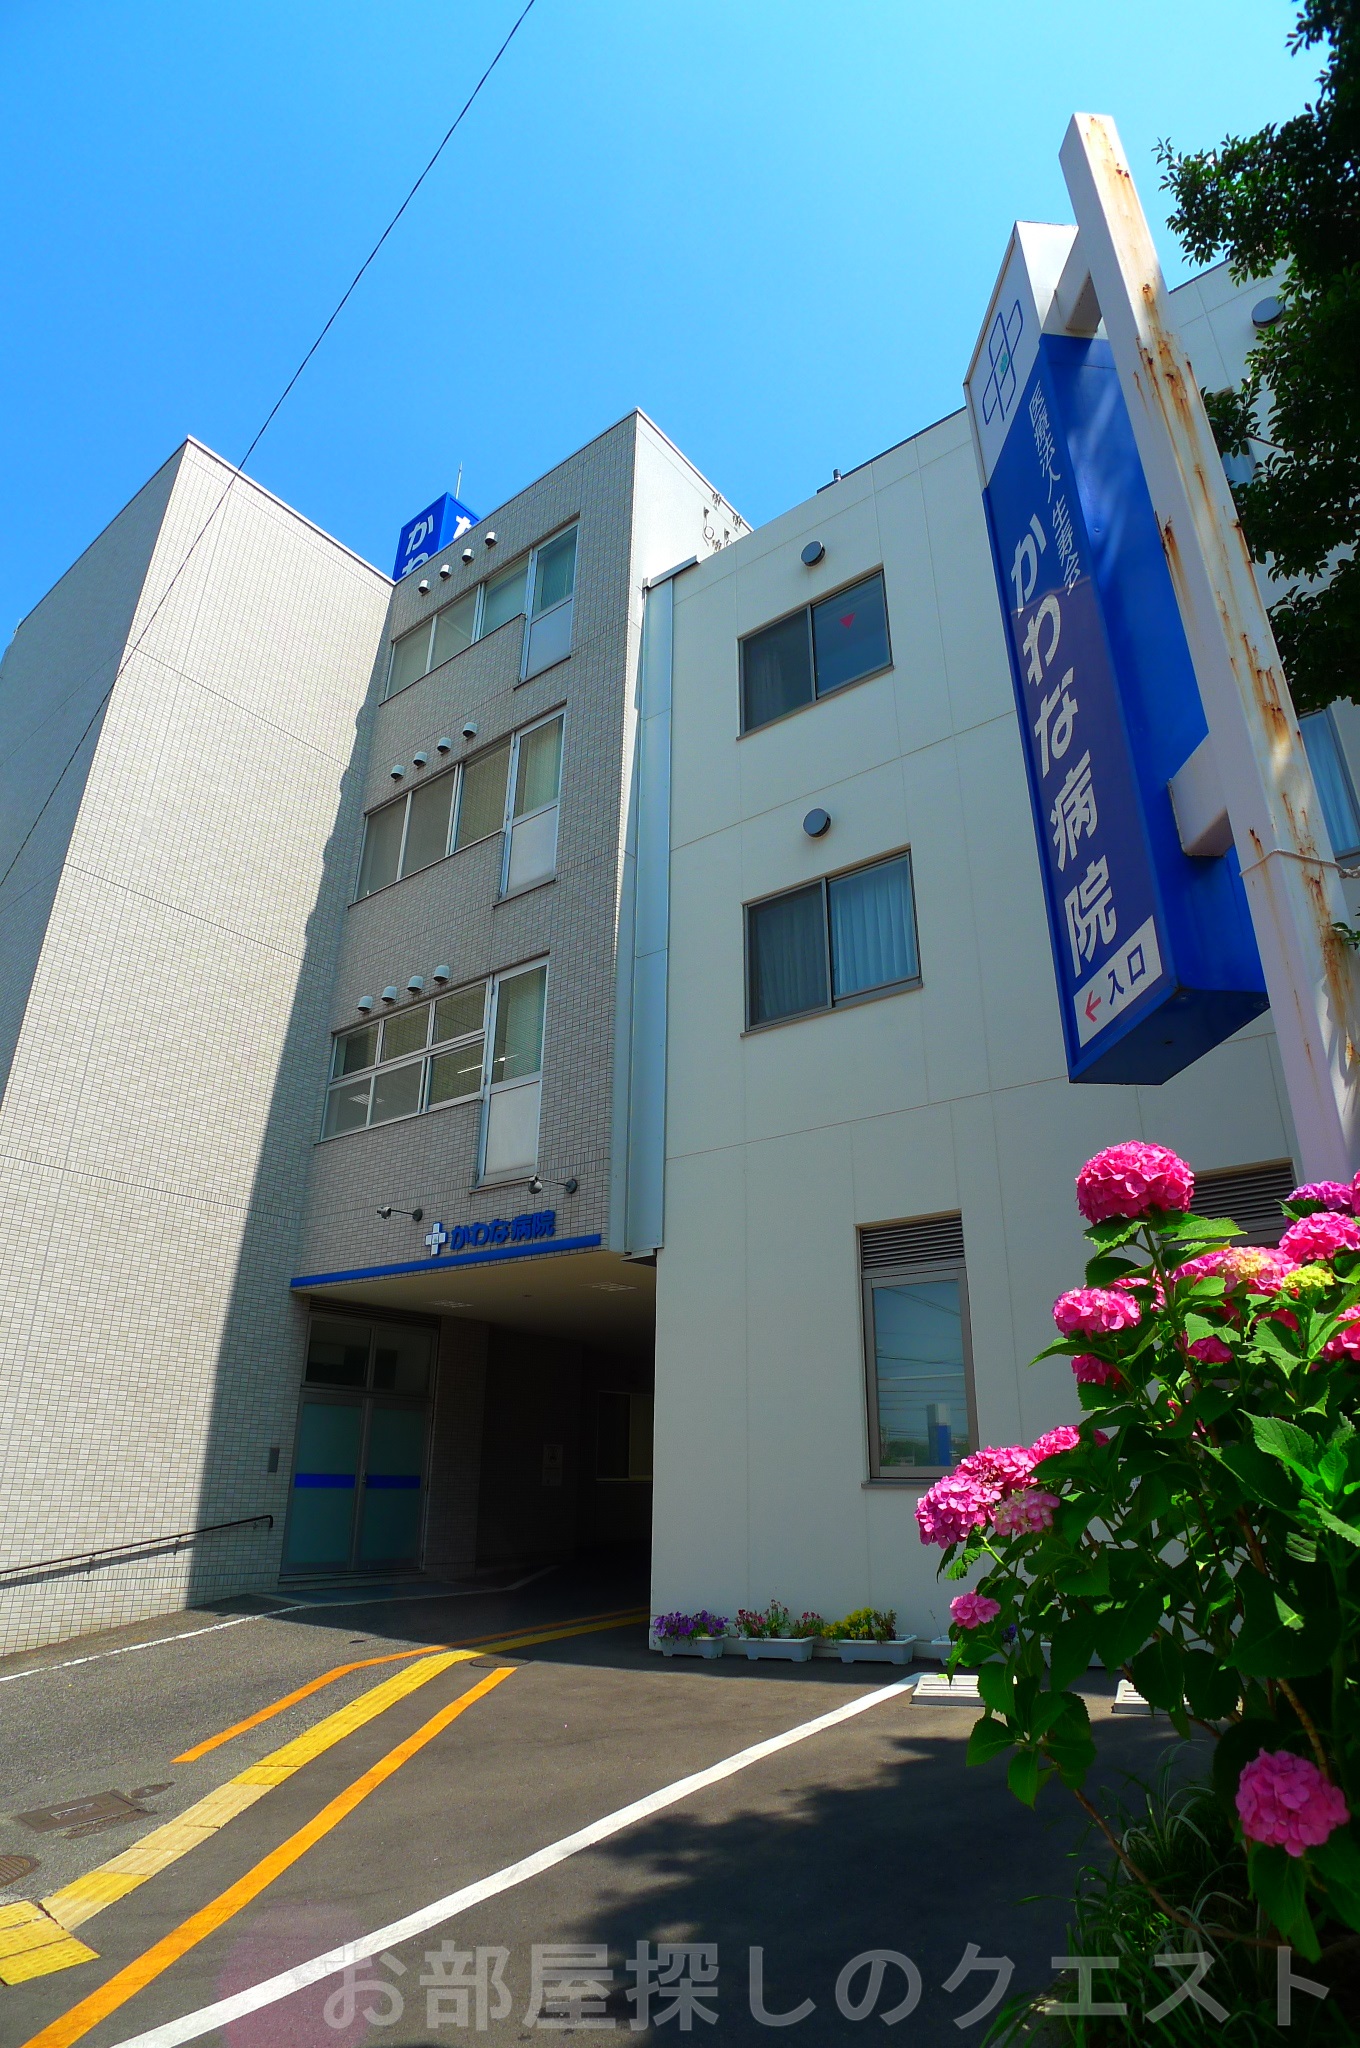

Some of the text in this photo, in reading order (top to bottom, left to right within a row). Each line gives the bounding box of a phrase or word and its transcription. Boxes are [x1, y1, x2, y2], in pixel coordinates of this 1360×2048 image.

[1011, 513, 1118, 978] かわな病院
[1108, 942, 1145, 1006] 入口
[450, 1209, 556, 1251] かわな病院
